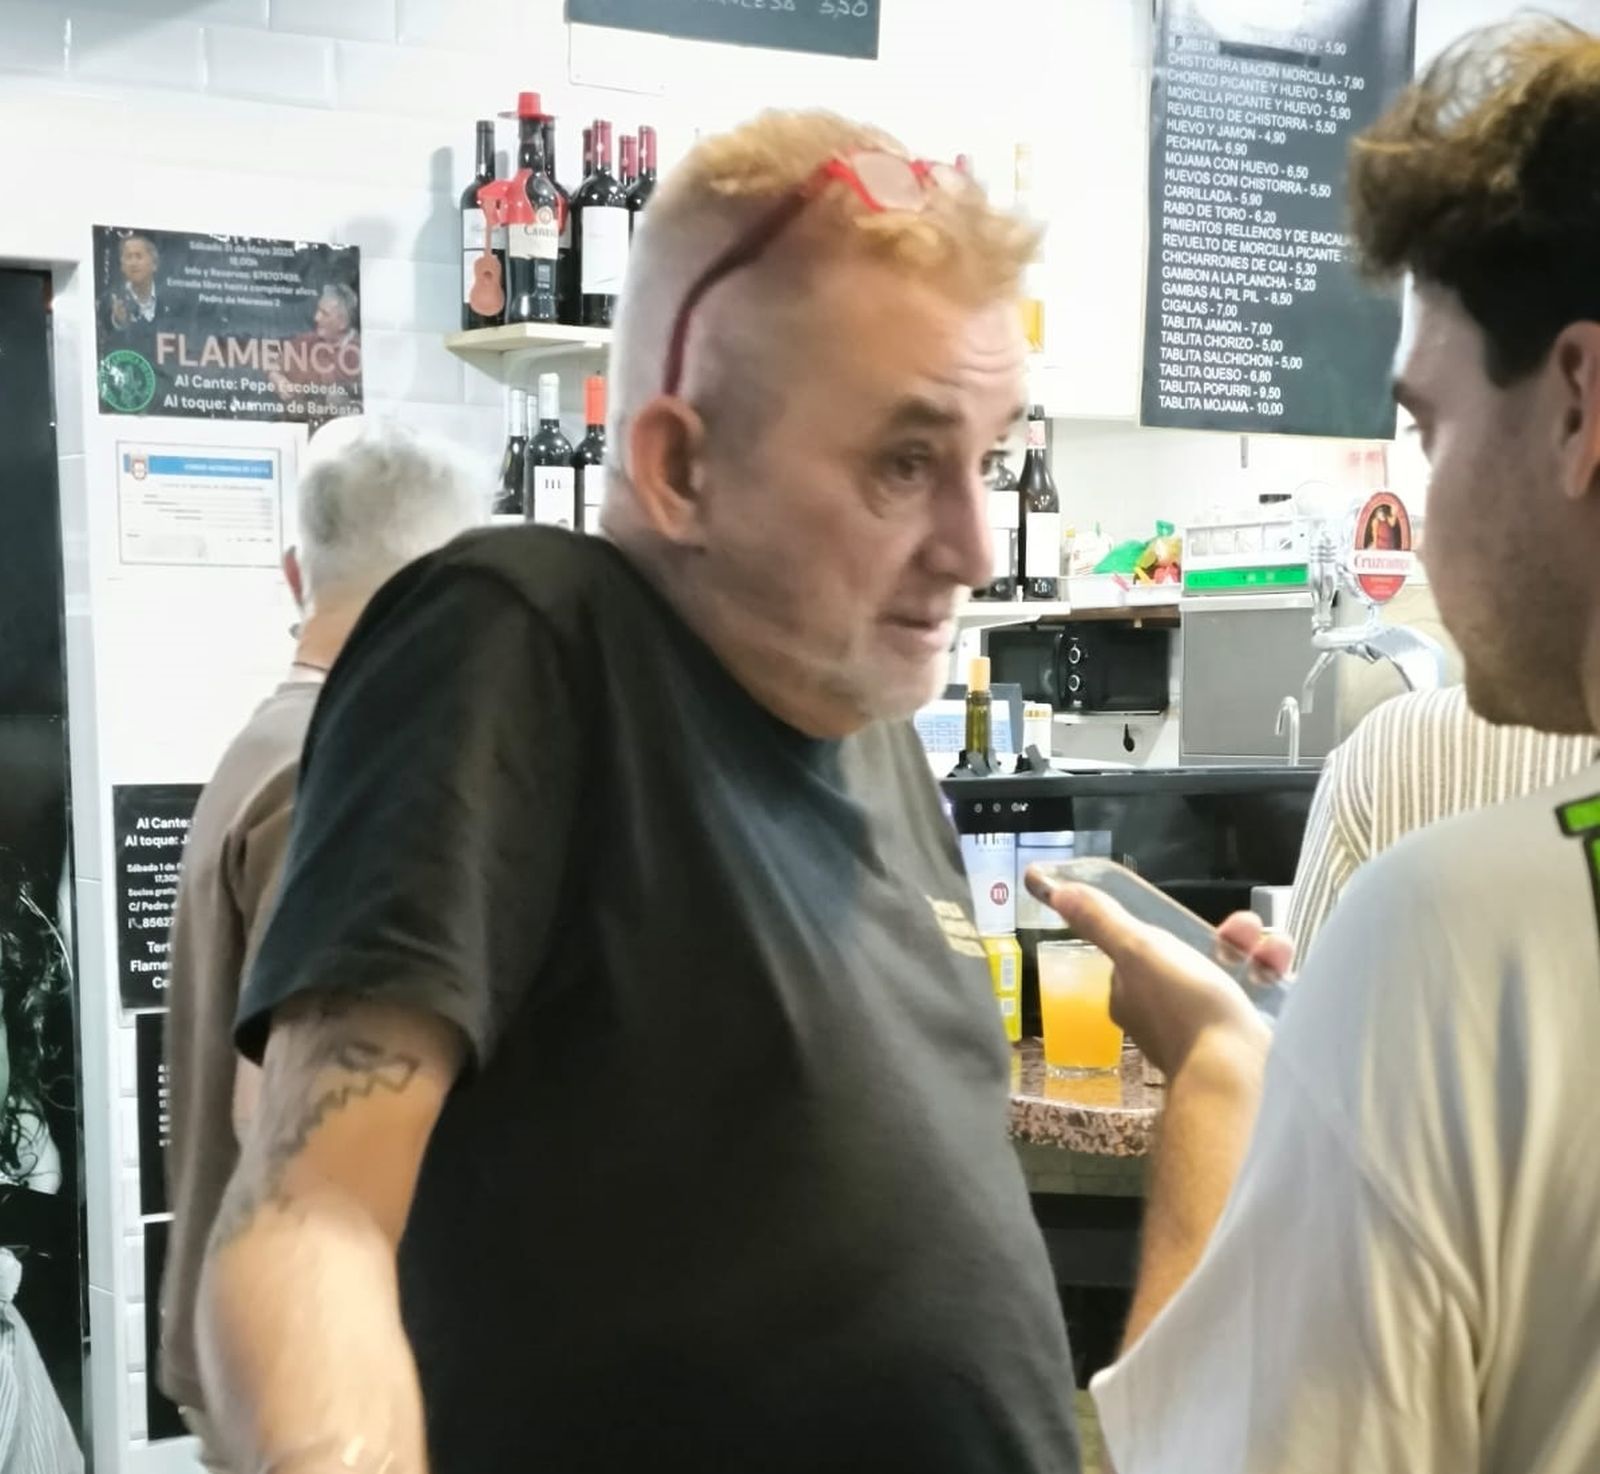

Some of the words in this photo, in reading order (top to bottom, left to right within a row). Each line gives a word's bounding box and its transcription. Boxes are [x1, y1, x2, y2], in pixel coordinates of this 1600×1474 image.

[1325, 41, 1346, 54] 5,90
[1168, 52, 1238, 72] CHISTTORRA
[1240, 62, 1278, 78] BACON
[1281, 67, 1336, 85] MORCILLA
[1343, 76, 1364, 90] 7,90
[1167, 70, 1217, 87] CHORIZO
[1222, 76, 1267, 93] PICANTE
[1271, 82, 1278, 94] Y
[1280, 83, 1317, 99] HUEVO
[1326, 89, 1347, 103] 5,90
[1167, 86, 1222, 103] MORCILLA
[1225, 93, 1271, 109] PICANTE
[1274, 99, 1281, 110] Y
[1284, 100, 1321, 115] HUEVO
[1330, 106, 1350, 119] 5,90
[1167, 103, 1224, 120] REVUELTO
[1227, 110, 1242, 122] DE
[1245, 112, 1307, 130] CHISTORRA
[1315, 120, 1336, 134] 5,50
[1166, 120, 1204, 134] HUEVO
[1207, 124, 1214, 135] Y
[1217, 125, 1255, 140] JAMON
[1264, 130, 1286, 144] 4,90
[1225, 142, 1247, 155] 6,90
[1165, 152, 1211, 167] MOJAMA
[1213, 157, 1238, 170] CON
[1241, 159, 1278, 174] HUEVO
[1287, 164, 1308, 178] 6,50
[1165, 169, 1210, 184] HUEVOS
[1212, 174, 1237, 187] CON
[1239, 176, 1301, 193] CHISTORRA
[1310, 183, 1331, 197] 5,50
[1164, 185, 1232, 202] CARRILLADA
[1240, 192, 1262, 206] 5,90
[1163, 202, 1194, 215] RABO
[1196, 205, 1212, 217] DE
[1215, 206, 1246, 220] TORO
[1254, 210, 1276, 223] 6,20
[1163, 218, 1222, 234] PIMIENTOS
[1225, 224, 1281, 240] RELLENOS
[1284, 230, 1291, 241] Y
[1294, 230, 1308, 242] DE
[1163, 234, 1220, 250] REVUELTO
[1222, 240, 1237, 252] DE
[1239, 242, 1293, 257] MORCILLA
[1296, 247, 1341, 262] PICANTE
[1162, 251, 1248, 269] CHICHARRONES
[1251, 258, 1266, 270] DE
[1268, 260, 1287, 272] CAI
[1295, 262, 1317, 275] 5,30
[1161, 267, 1209, 281] GAMBON
[1210, 271, 1219, 282] A
[1221, 272, 1234, 283] LA
[1236, 273, 1287, 288] PLANCHA
[1294, 278, 1316, 291] 5,20
[1161, 283, 1207, 297] GAMBAS
[1209, 287, 1222, 298] AL
[1224, 288, 1240, 300] PIL
[1243, 289, 1259, 301] PIL
[1161, 299, 1208, 313] CIGALAS
[1216, 303, 1237, 316] 7,00
[1161, 316, 1203, 329] TABLITA
[1204, 319, 1242, 332] JAMON
[1250, 322, 1272, 335] 7,00
[1161, 332, 1202, 345] TABLITA
[1203, 335, 1253, 349] CHORIZO
[1261, 339, 1283, 352] 5,00
[156, 332, 361, 376] FLAMENCO
[1160, 348, 1201, 362] TABLITA
[1203, 351, 1272, 366] SALCHICHON
[1281, 356, 1302, 369] 5,00
[1160, 365, 1201, 378] TABLITA
[1203, 367, 1241, 380] QUESO
[174, 374, 189, 388] Al
[191, 376, 238, 392] Cante:
[240, 378, 275, 394] Pepe
[1160, 381, 1201, 394] TABLITA
[1203, 383, 1251, 397] POPURRI
[1259, 387, 1281, 399] 9,50
[163, 394, 178, 408] Al
[181, 396, 227, 413] toque:
[287, 399, 304, 414] de
[1159, 397, 1201, 409] TABLITA
[1203, 399, 1248, 412] MOJAMA
[1257, 402, 1283, 415] 10,00
[136, 817, 150, 829] Al
[125, 835, 138, 847] Al
[140, 836, 179, 849] toque:
